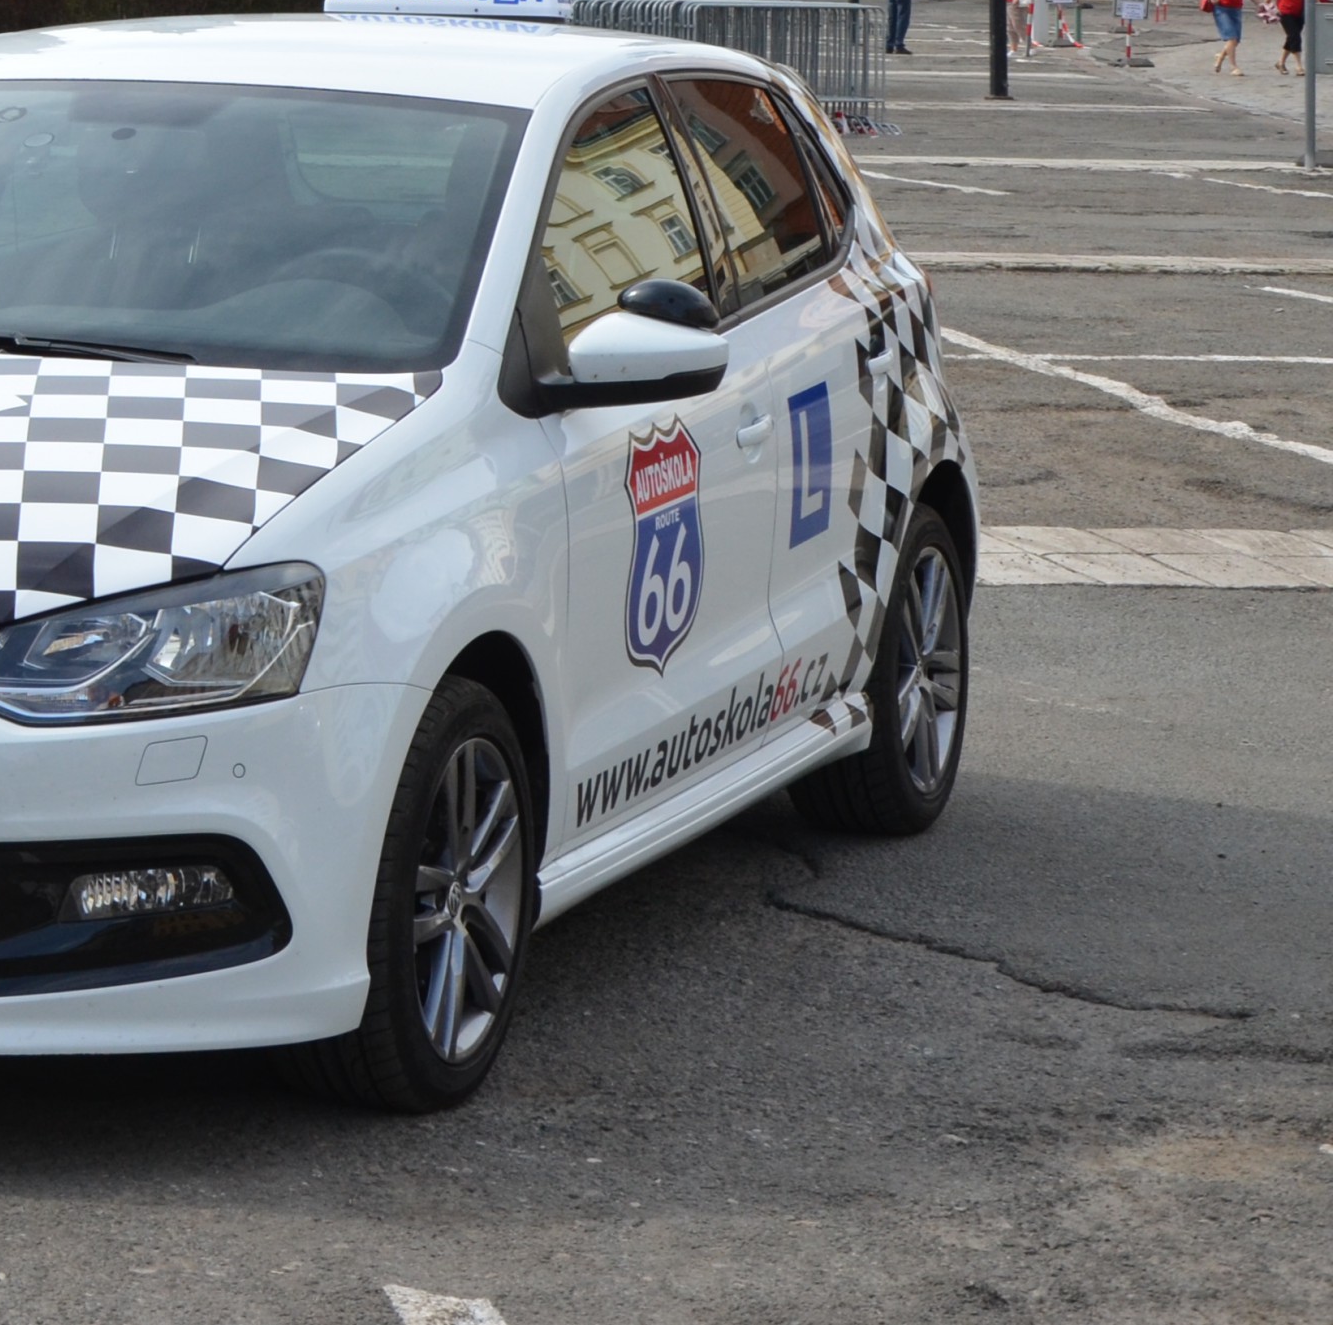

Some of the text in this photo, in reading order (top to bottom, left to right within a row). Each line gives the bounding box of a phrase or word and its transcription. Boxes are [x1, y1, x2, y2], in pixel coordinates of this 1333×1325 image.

[635, 450, 694, 494] AUTOŠKOLA
[654, 507, 681, 529] ROUTE
[798, 409, 823, 520] L
[637, 520, 694, 646] 66
[576, 652, 829, 828] www.autoskola66.cz
